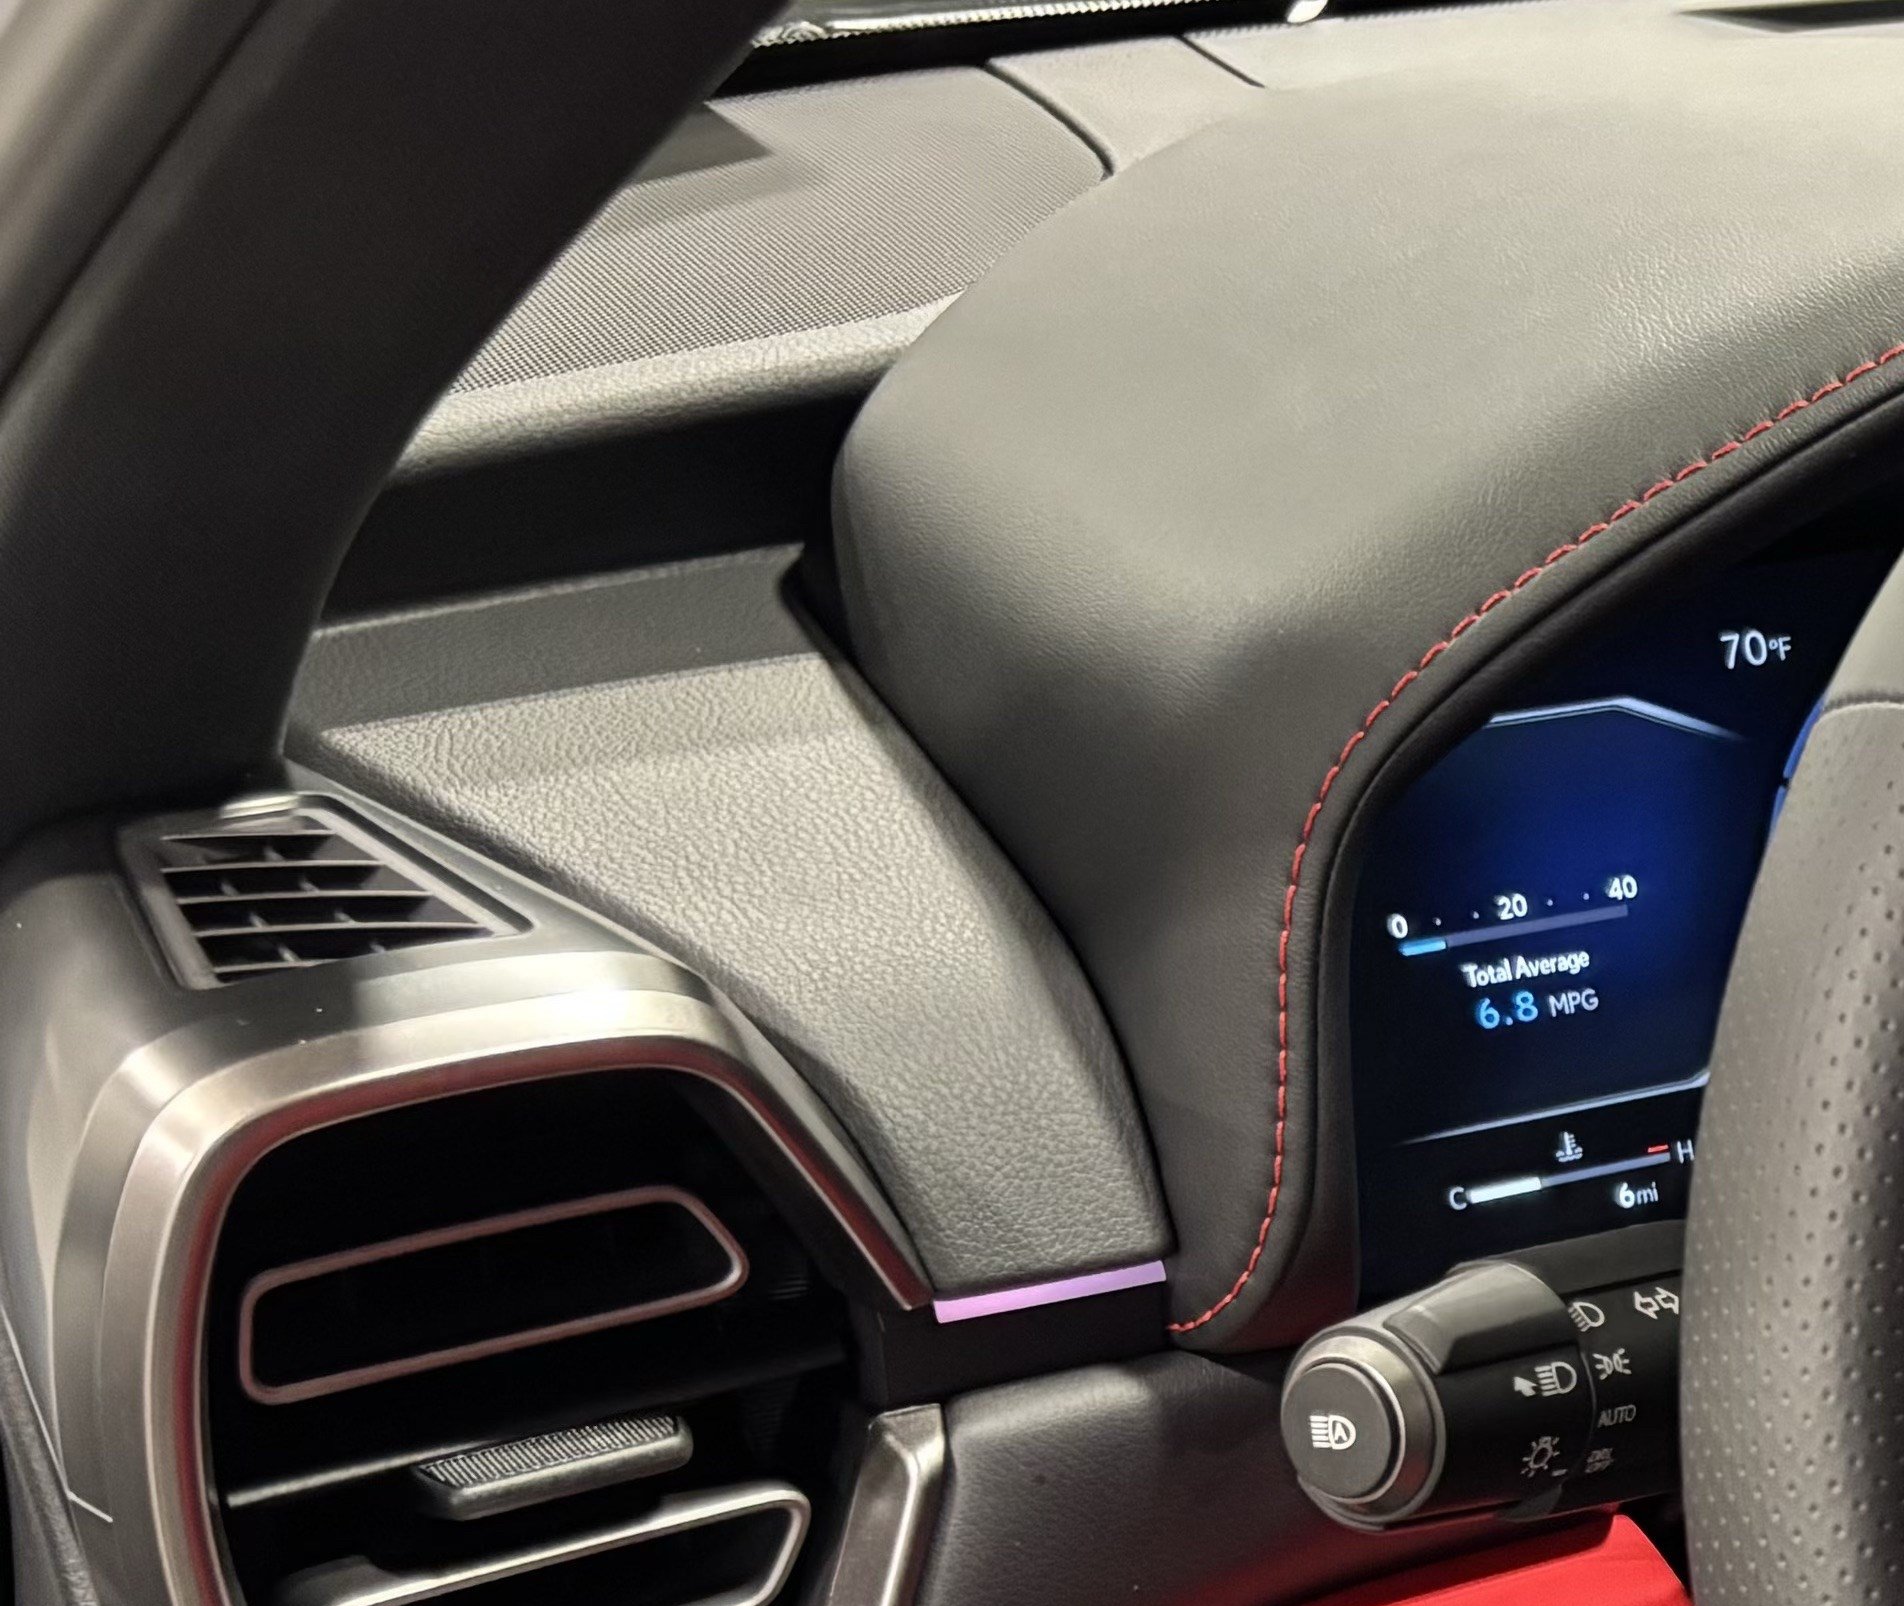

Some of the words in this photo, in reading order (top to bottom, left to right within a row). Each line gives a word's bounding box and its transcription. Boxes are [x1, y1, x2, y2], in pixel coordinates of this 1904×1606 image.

[1389, 912, 1410, 941] 0
[1499, 893, 1529, 921] 20
[1607, 874, 1639, 902] 40
[1463, 961, 1513, 989] Total
[1513, 949, 1591, 982] Average
[1477, 991, 1540, 1031] 6.8
[1548, 988, 1600, 1019] MPG
[1448, 1186, 1469, 1212] C
[1598, 1404, 1637, 1427] AUTO
